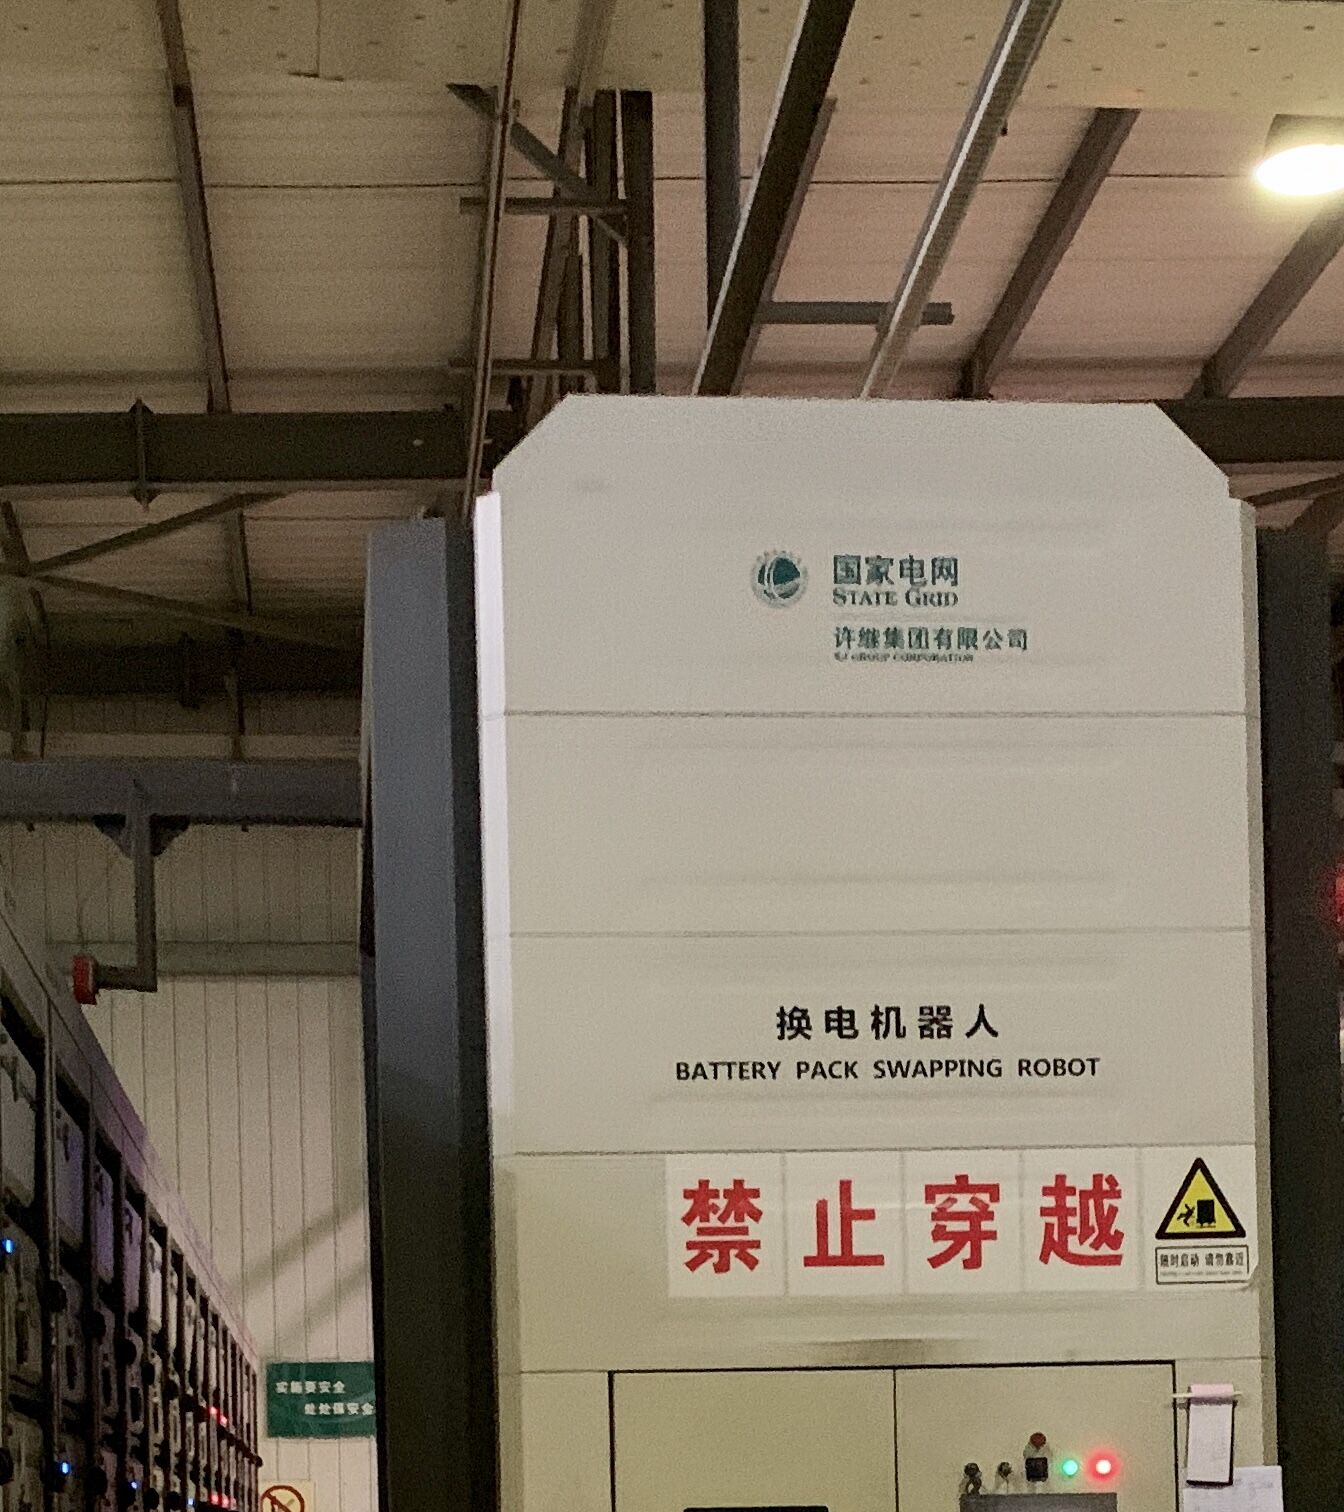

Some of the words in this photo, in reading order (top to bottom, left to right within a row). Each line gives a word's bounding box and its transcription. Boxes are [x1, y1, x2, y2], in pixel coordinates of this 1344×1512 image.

[833, 553, 958, 586] 国家电网
[833, 587, 898, 607] STATE
[905, 586, 959, 607] GRID
[776, 1003, 999, 1040] 换电机器人
[676, 1060, 781, 1080] BATTERY
[796, 1060, 859, 1079] PACK
[873, 1058, 1003, 1079] SWAPPING
[1018, 1057, 1100, 1077] ROBOT
[681, 1174, 1125, 1274] 禁止穿越
